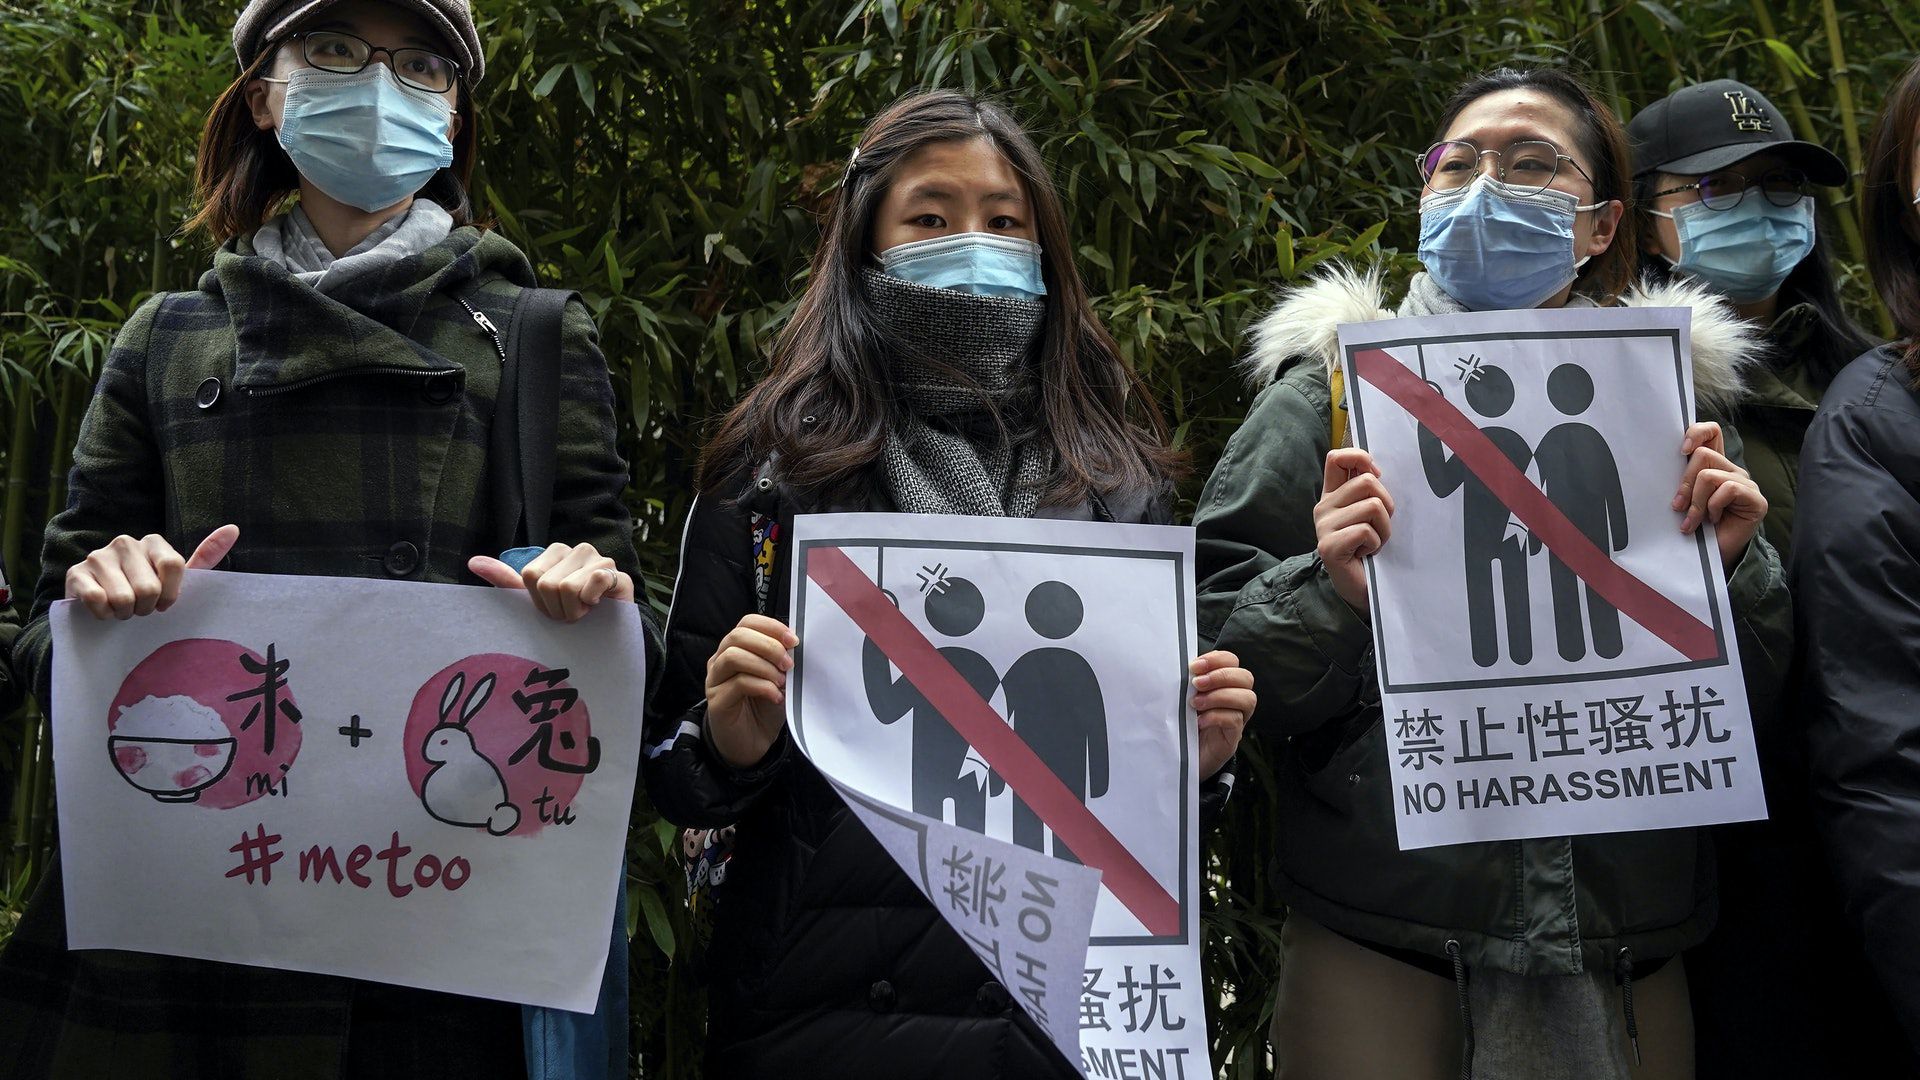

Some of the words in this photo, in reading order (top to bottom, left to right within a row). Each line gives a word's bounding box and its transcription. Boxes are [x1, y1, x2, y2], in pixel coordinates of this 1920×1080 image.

[1723, 91, 1773, 133] LA
[226, 643, 302, 754] 米
[1394, 685, 1732, 771] 禁止性骚扰
[245, 762, 289, 798] mi
[1403, 782, 1447, 816] NO
[1456, 756, 1737, 810] HARASSMENT
[532, 787, 577, 825] tu
